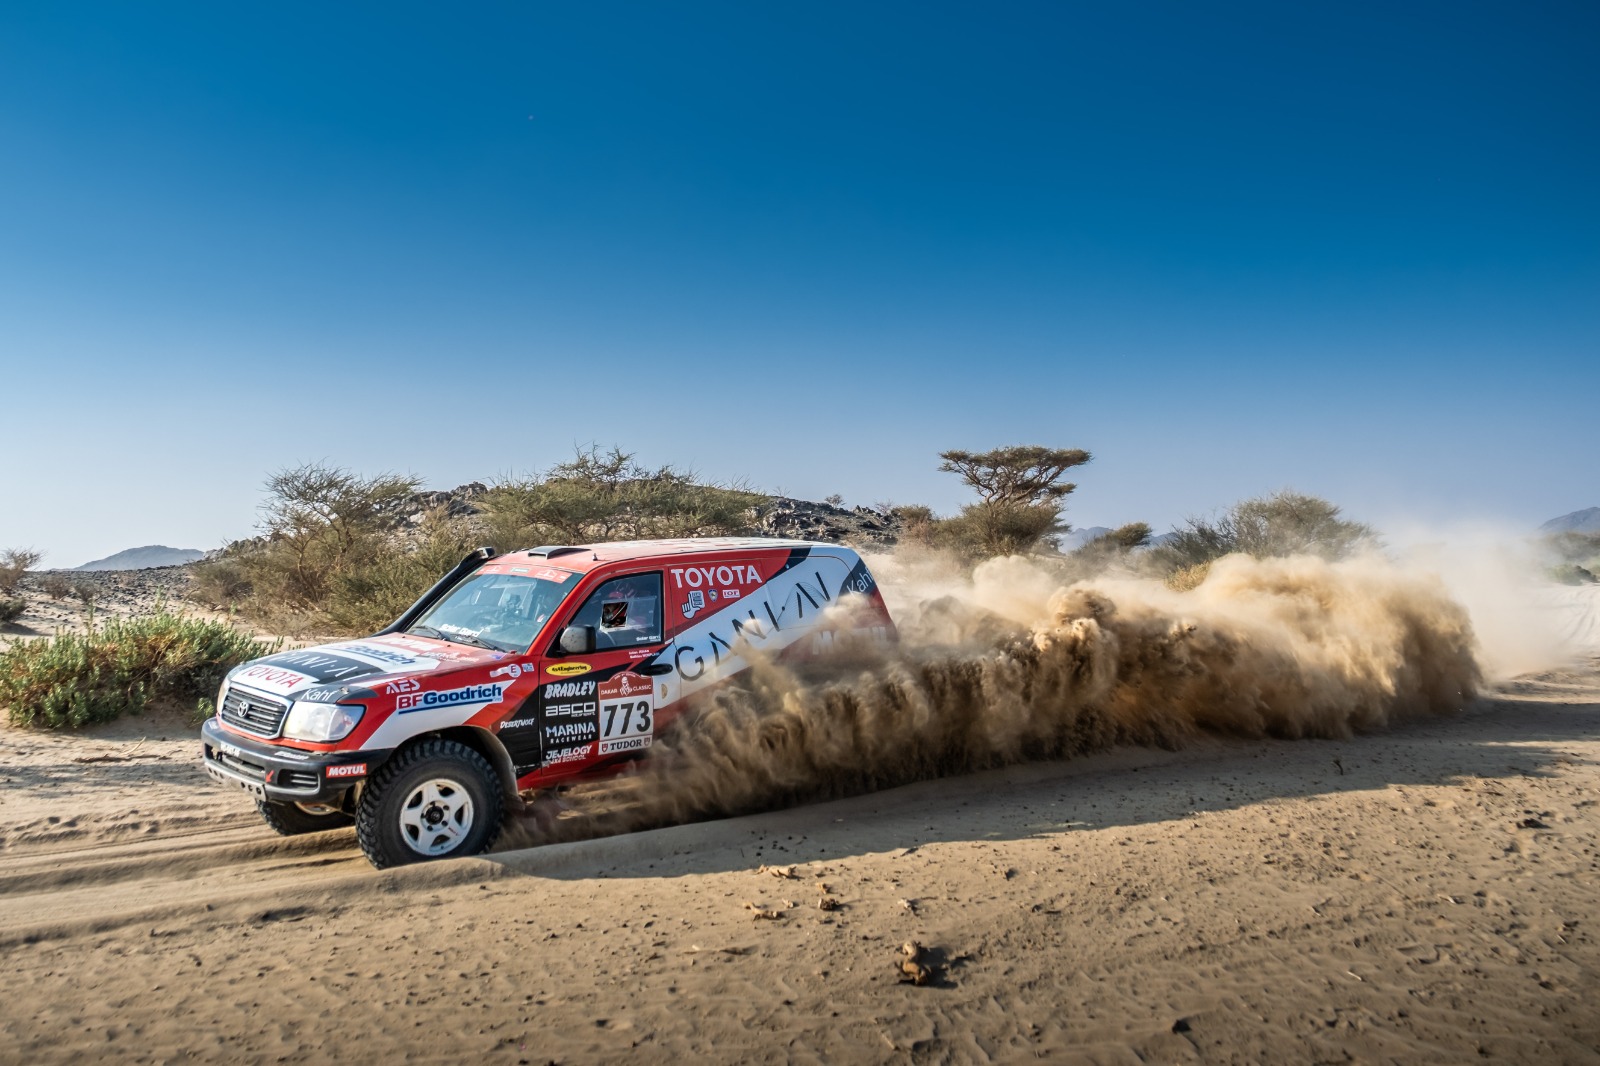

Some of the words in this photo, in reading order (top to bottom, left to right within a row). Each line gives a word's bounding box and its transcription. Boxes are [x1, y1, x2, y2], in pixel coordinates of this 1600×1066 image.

[671, 565, 763, 588] TOYOTA
[399, 684, 502, 709] BFGoodrich
[544, 681, 596, 699] BRADLEY
[603, 700, 651, 737] 773
[545, 722, 596, 738] MARINA
[550, 734, 592, 744] RACEWEAR
[610, 739, 643, 751] TUDOR
[545, 745, 592, 760] JEJELOGY
[328, 765, 365, 776] MOTUL
